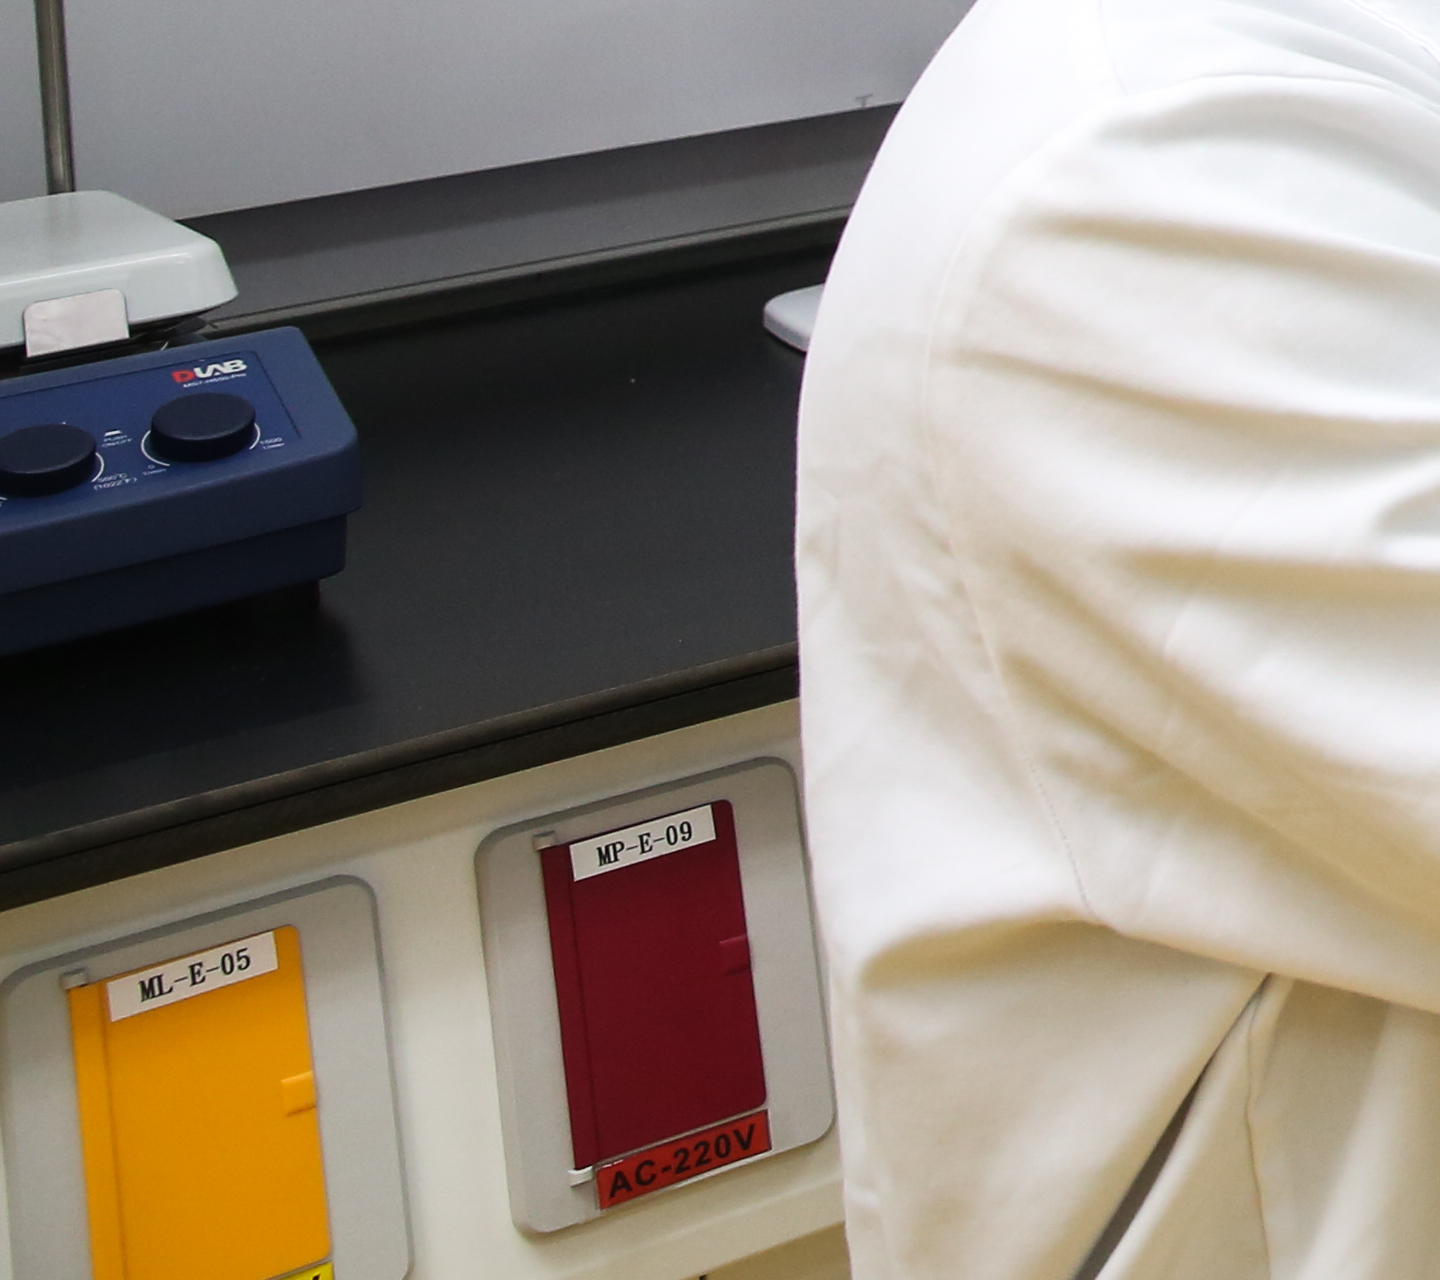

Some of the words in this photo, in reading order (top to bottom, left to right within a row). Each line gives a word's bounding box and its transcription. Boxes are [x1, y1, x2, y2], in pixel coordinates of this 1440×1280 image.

[172, 359, 248, 383] DLAB
[596, 821, 693, 867] MP-E-09
[138, 947, 251, 1003] ML-E-05
[608, 1124, 756, 1199] AC-220V
